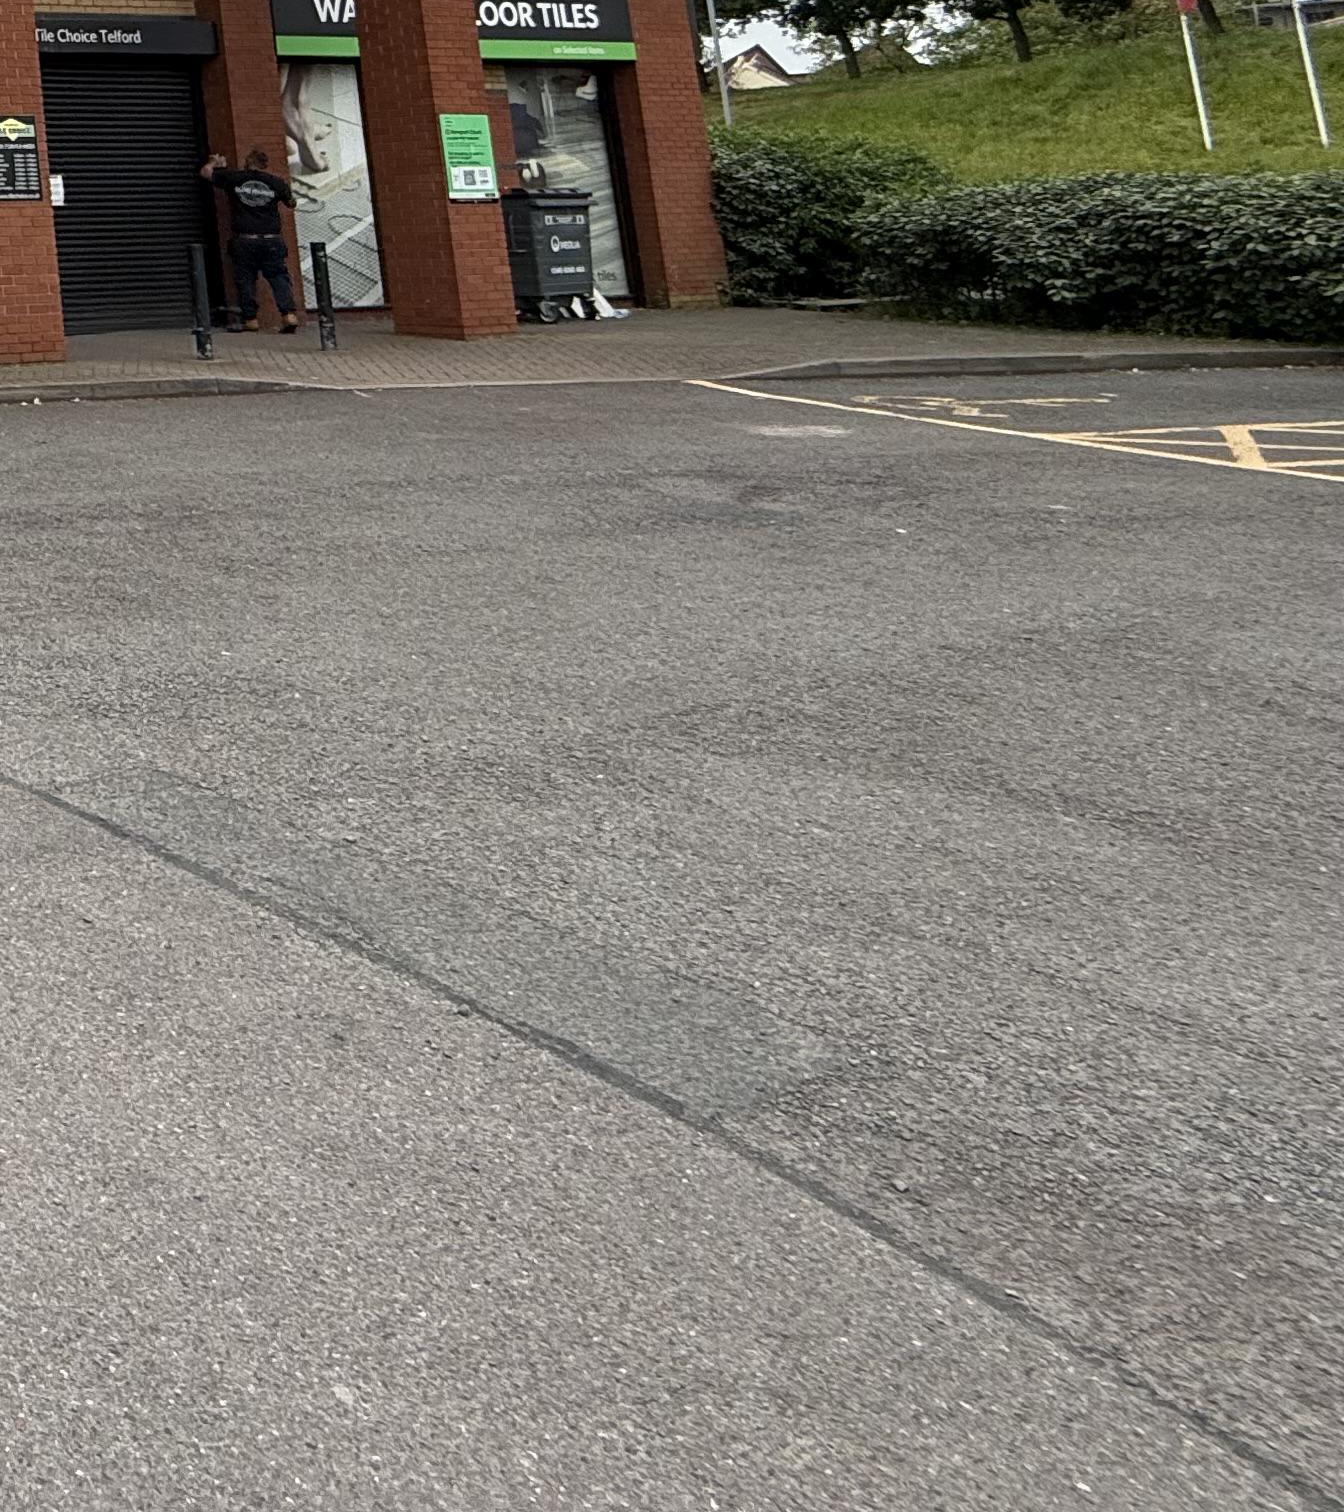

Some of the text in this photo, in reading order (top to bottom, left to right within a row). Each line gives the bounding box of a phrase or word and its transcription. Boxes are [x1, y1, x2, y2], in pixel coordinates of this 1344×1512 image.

[475, 1, 536, 27] OOR
[536, 2, 600, 29] TILES
[57, 29, 98, 43] Choice
[98, 30, 142, 44] Telford
